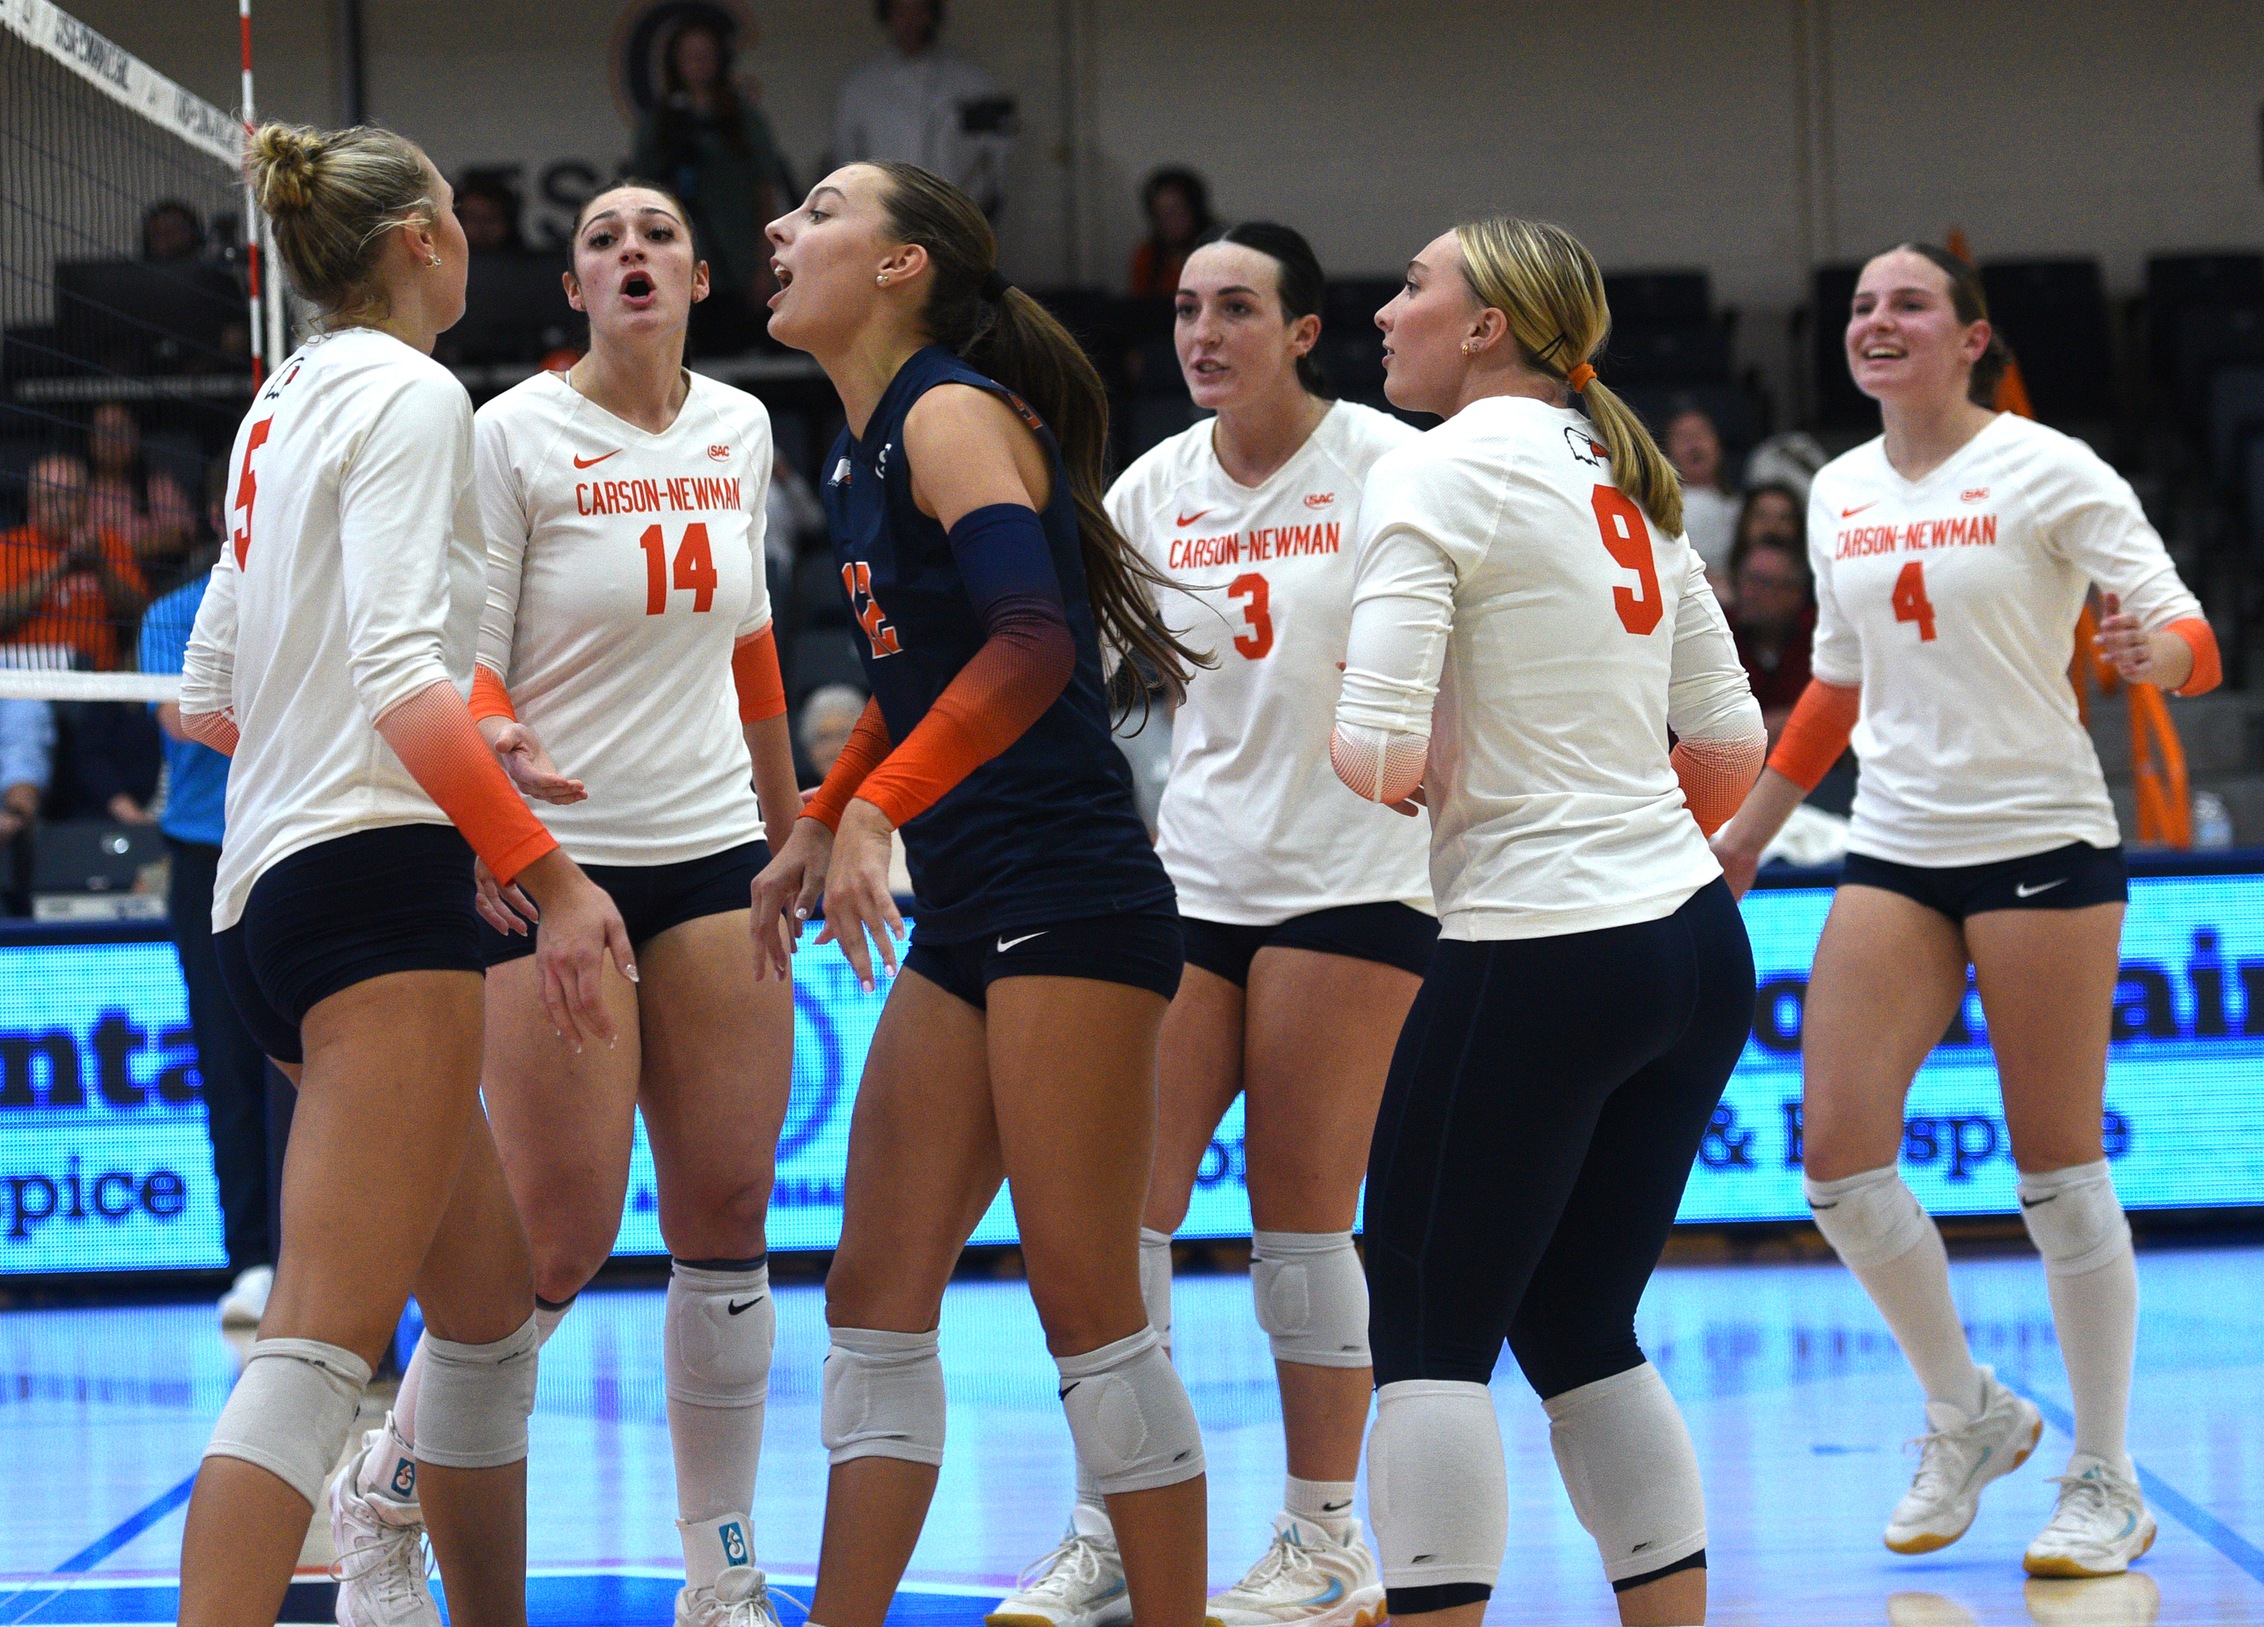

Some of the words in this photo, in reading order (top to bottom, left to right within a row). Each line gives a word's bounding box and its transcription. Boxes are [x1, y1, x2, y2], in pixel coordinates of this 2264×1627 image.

[233, 412, 275, 573] 5
[710, 444, 730, 457] SAC
[575, 477, 742, 516] CARSON-NEWMAN
[1836, 514, 1997, 560] CARSON-NEWMAN
[639, 522, 718, 616] 14
[1169, 521, 1340, 569] CARSON-NEWMAN
[1590, 484, 1664, 636] 9
[1227, 572, 1275, 661] 3
[1891, 559, 1938, 643] 4
